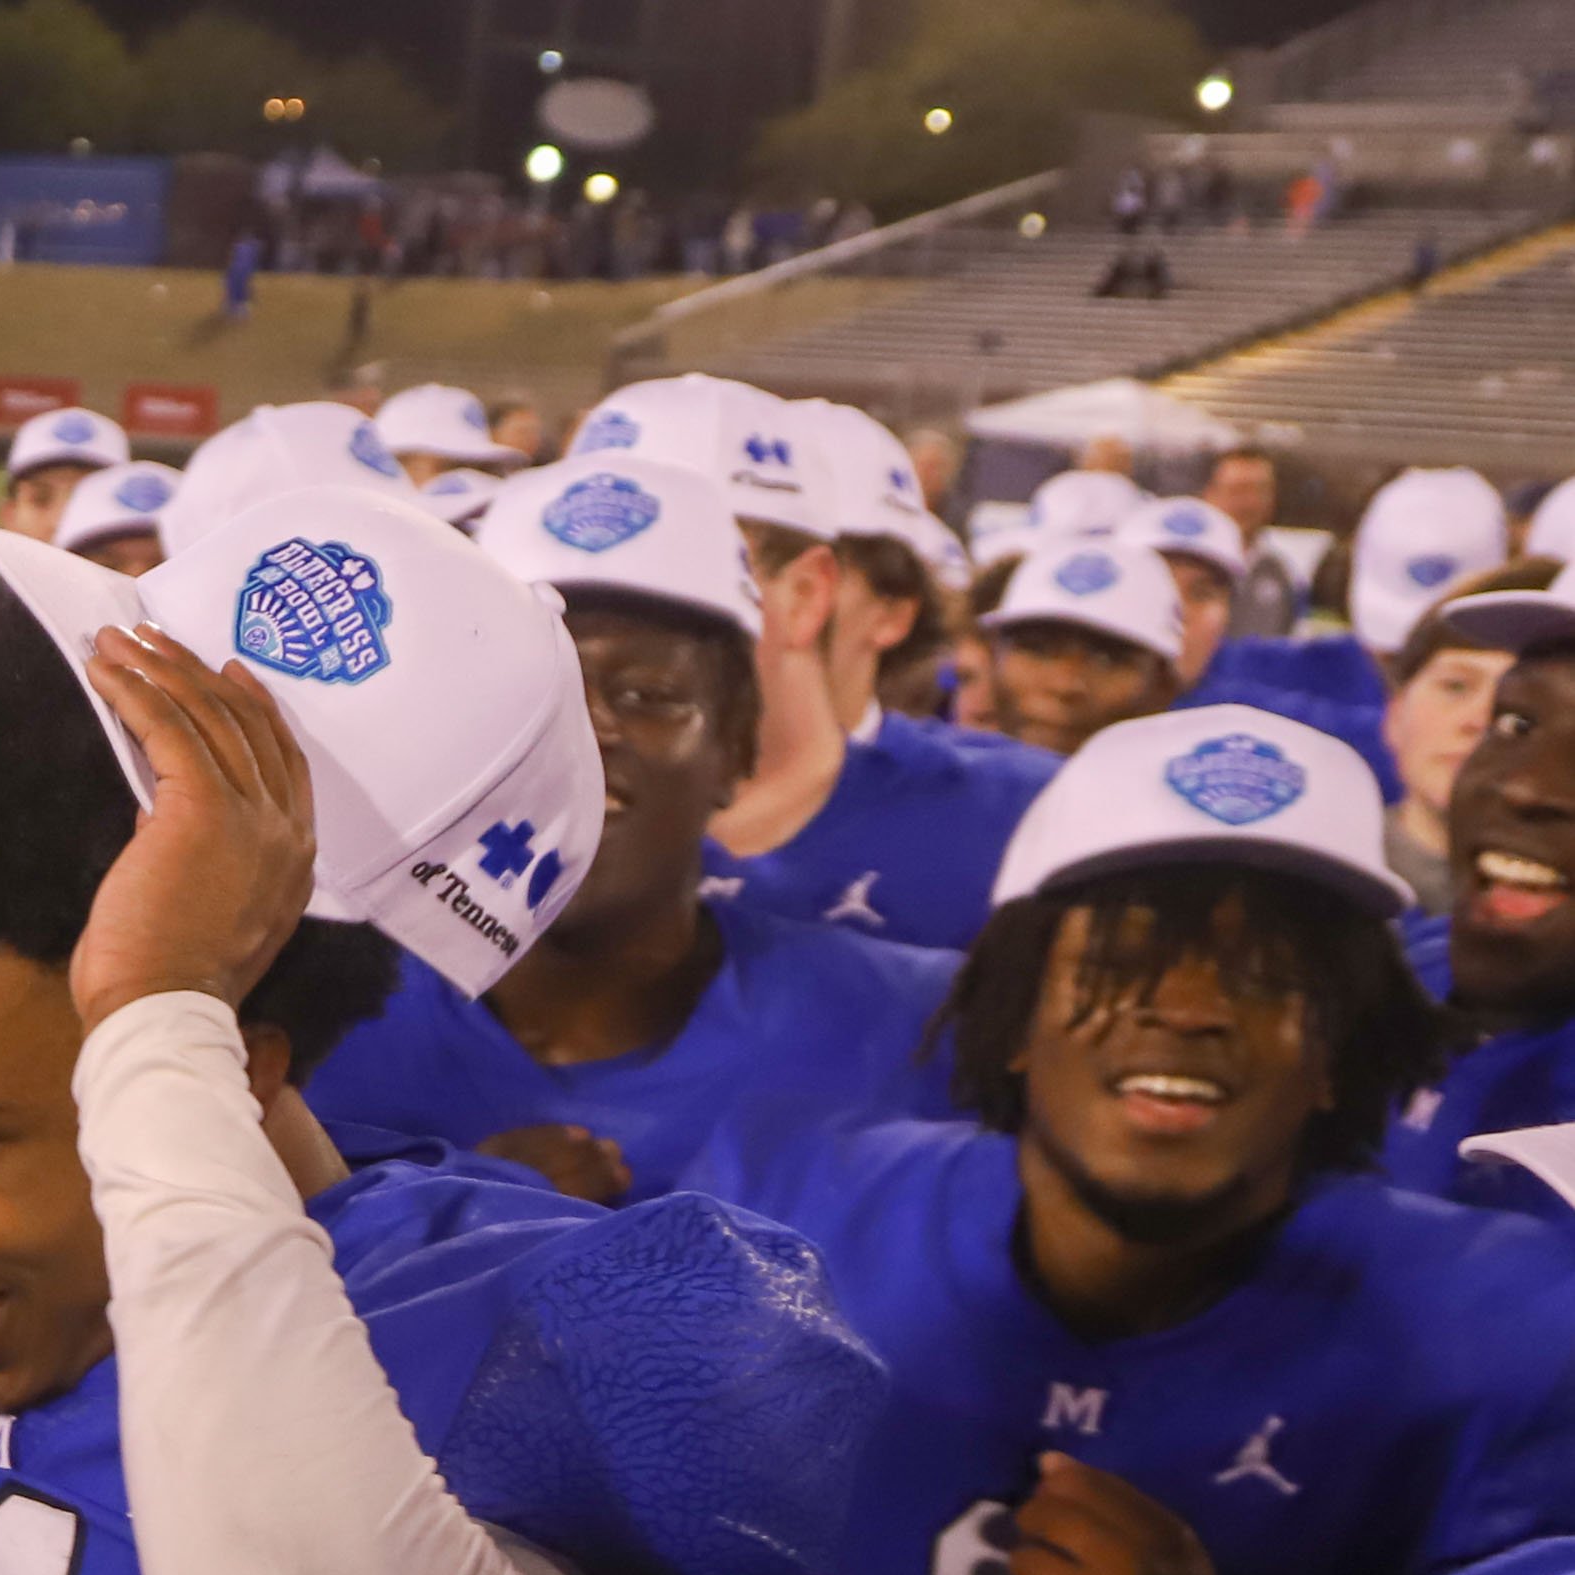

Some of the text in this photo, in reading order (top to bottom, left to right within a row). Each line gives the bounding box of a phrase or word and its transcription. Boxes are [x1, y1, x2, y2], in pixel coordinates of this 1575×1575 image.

[266, 542, 379, 676] BLUECROSS
[274, 578, 329, 647] BOWL
[410, 861, 448, 887] of
[1042, 1381, 1110, 1435] M
